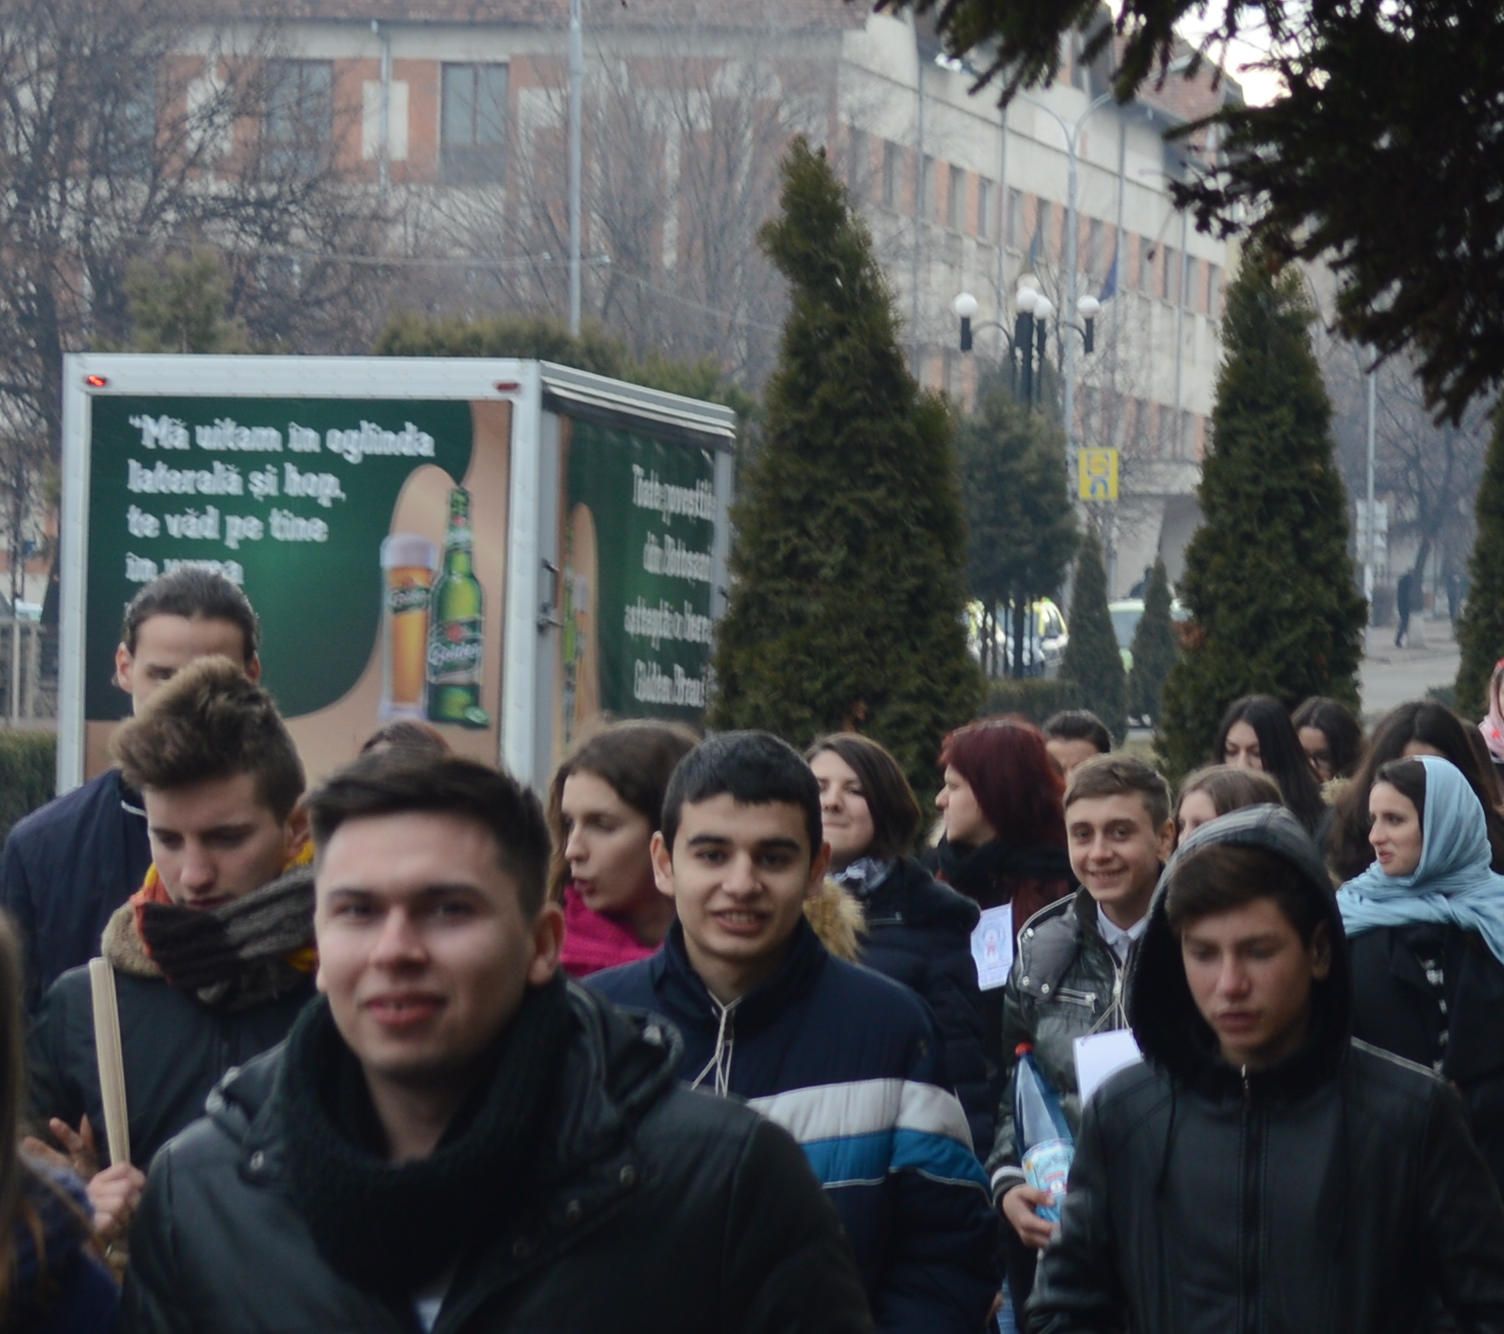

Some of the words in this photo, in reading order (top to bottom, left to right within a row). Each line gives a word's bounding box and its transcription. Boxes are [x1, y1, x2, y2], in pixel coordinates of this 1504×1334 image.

[195, 417, 284, 452] uitam
[326, 420, 435, 464] oglinda
[127, 459, 244, 495] laterală
[284, 462, 346, 507] hop,
[126, 505, 161, 538] te
[164, 505, 221, 539] văd
[224, 514, 265, 549] pe
[268, 508, 329, 542] tine
